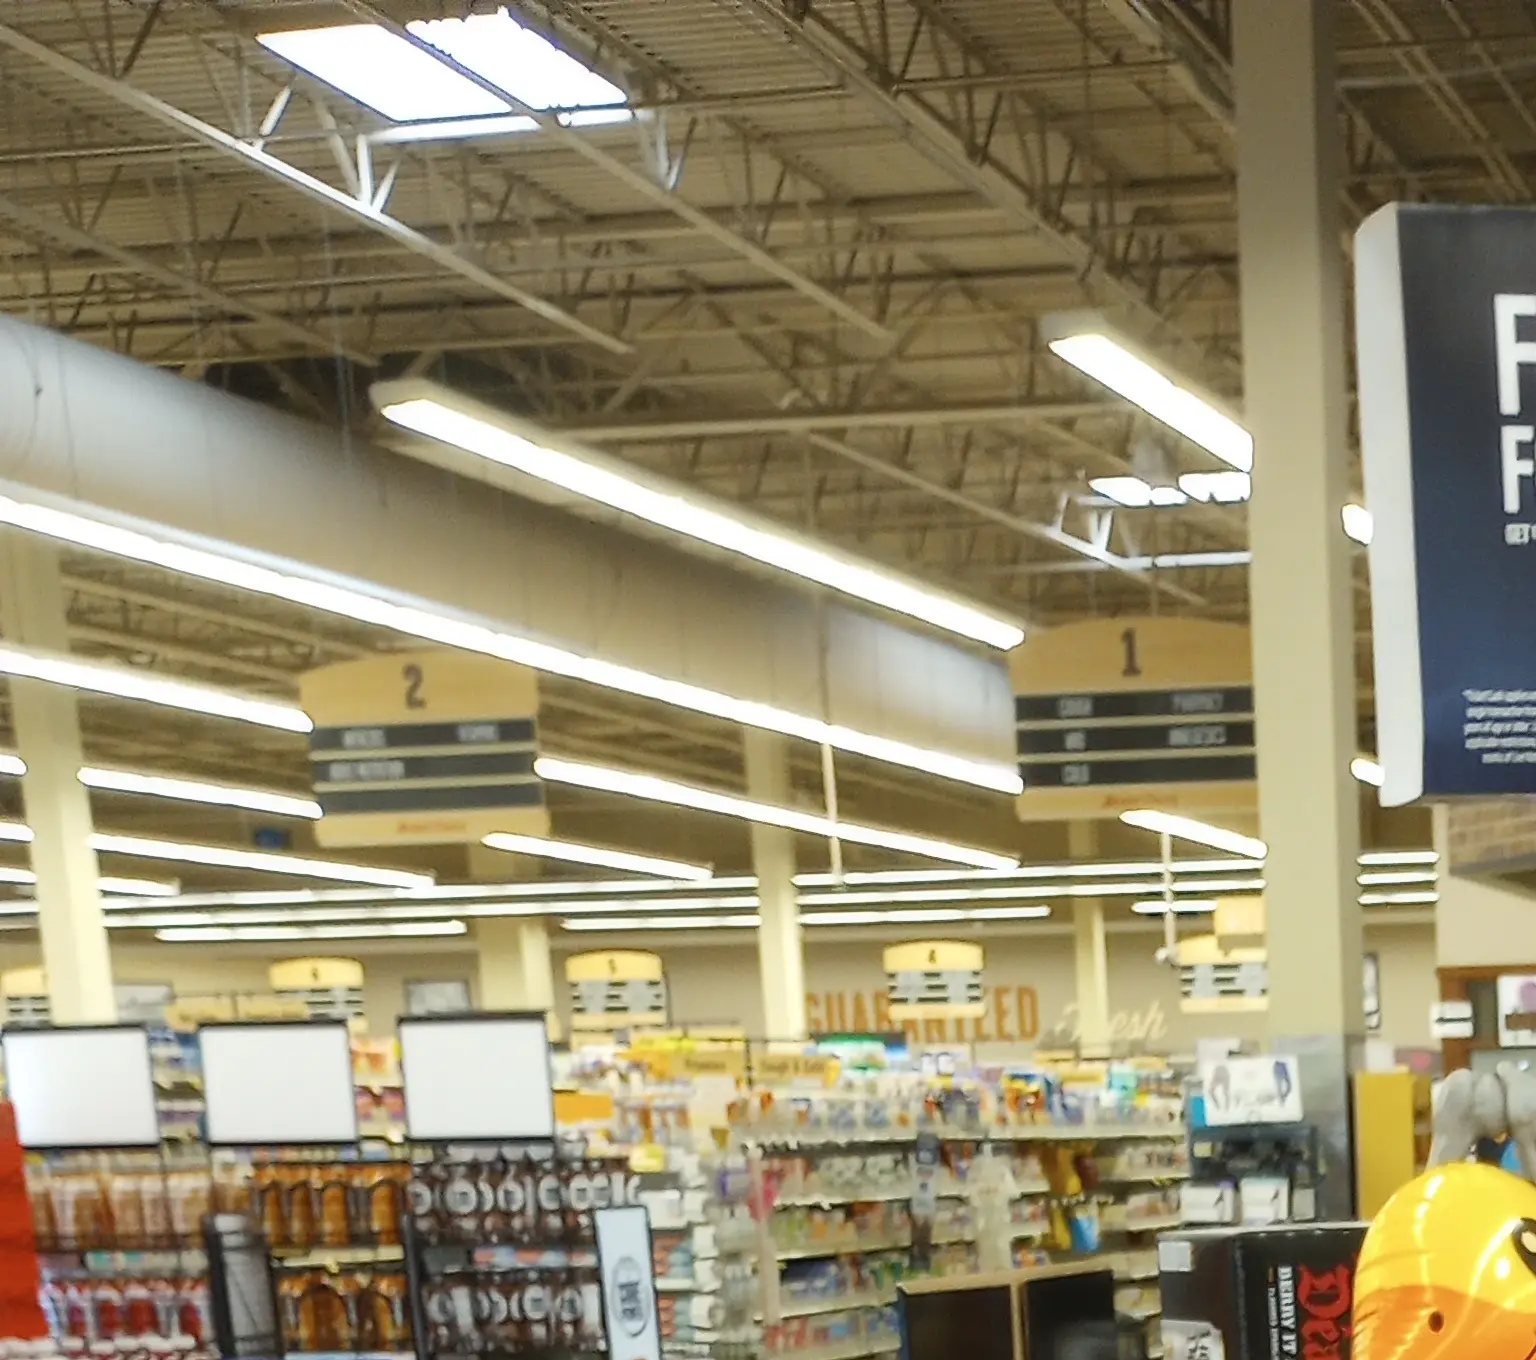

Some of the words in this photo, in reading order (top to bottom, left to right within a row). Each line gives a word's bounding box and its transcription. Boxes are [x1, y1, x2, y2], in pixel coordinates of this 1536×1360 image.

[1120, 626, 1142, 678] 1
[402, 663, 427, 710] 2
[1277, 1266, 1297, 1329] BERRY
[1281, 1332, 1298, 1355] IT
